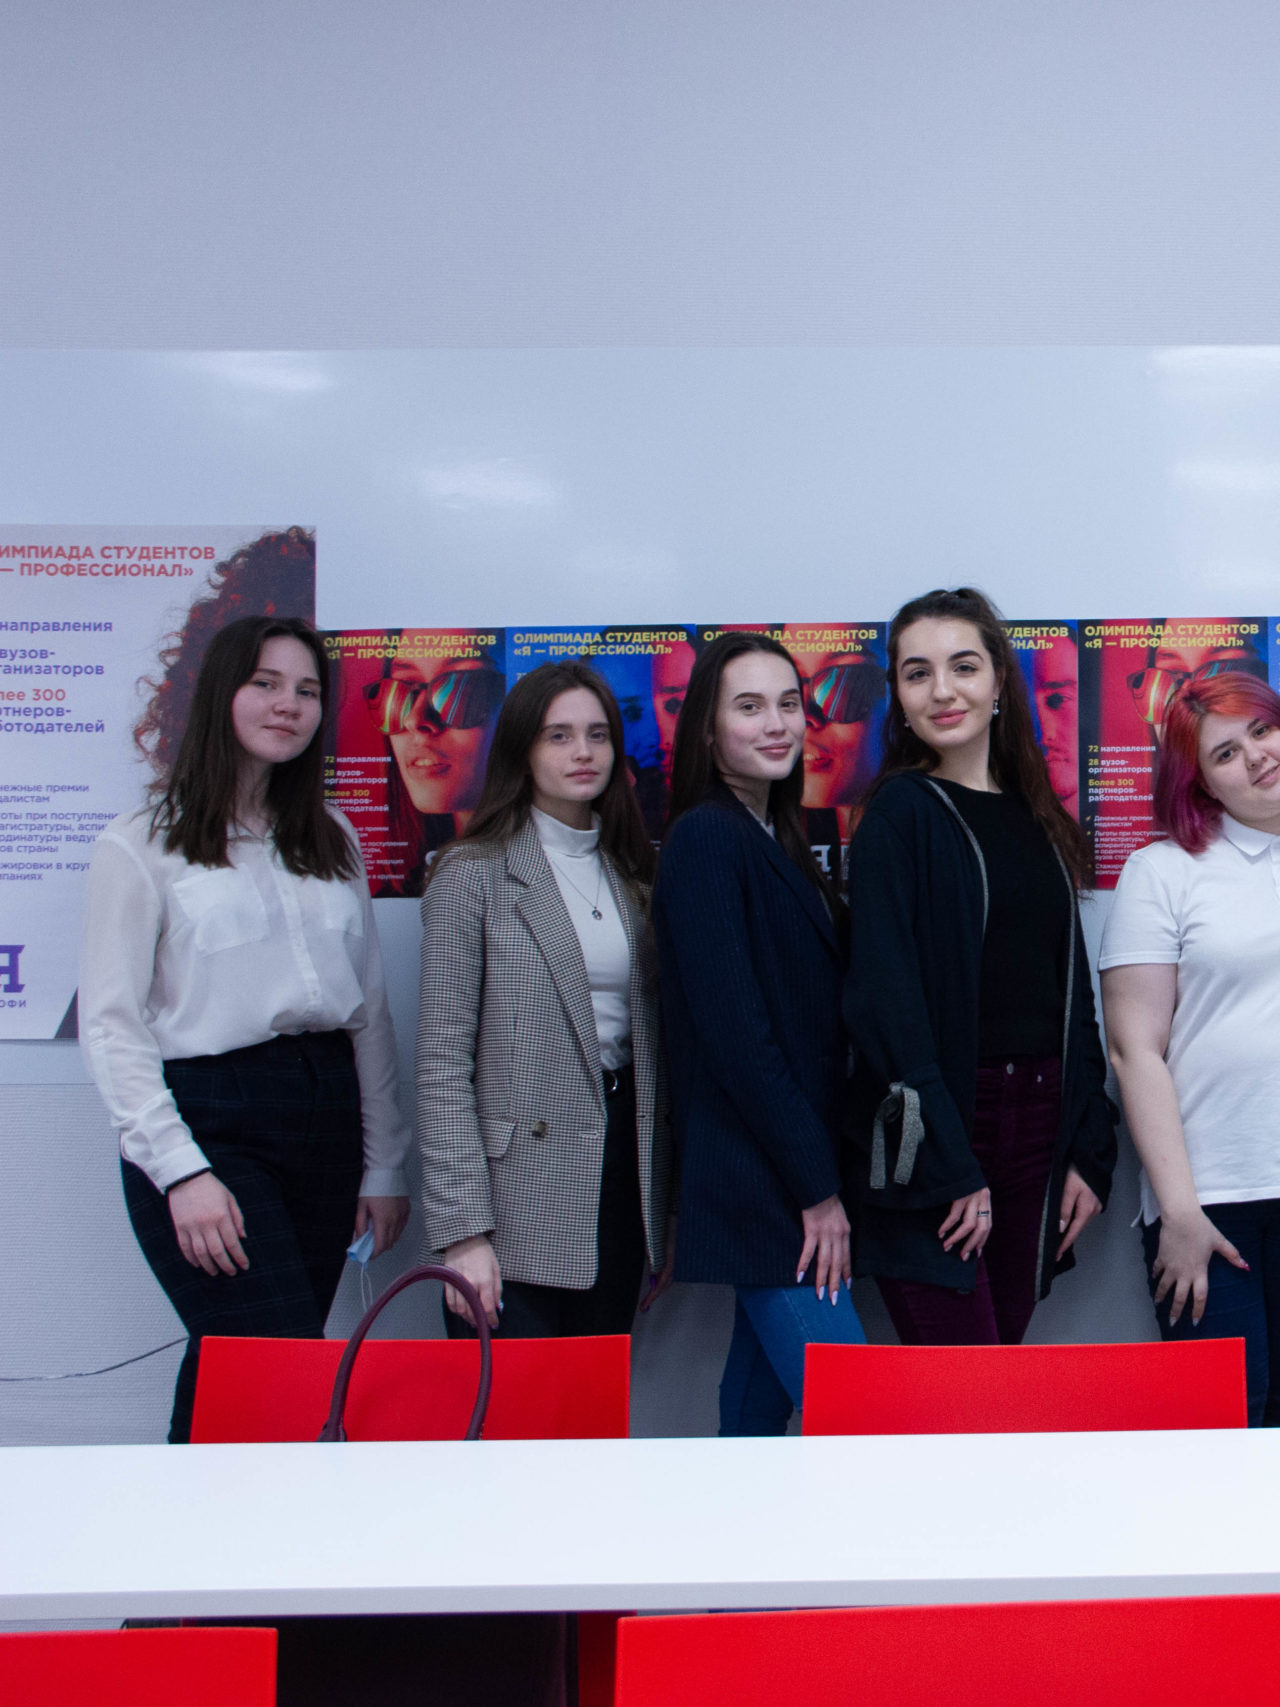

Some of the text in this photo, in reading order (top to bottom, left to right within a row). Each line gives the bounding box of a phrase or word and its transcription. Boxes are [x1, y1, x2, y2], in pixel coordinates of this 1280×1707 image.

[100, 546, 215, 560] СТУДЕНТОВ
[20, 563, 194, 577] ПРОФЕССИОНАЛ»
[0, 621, 113, 633] направления
[1085, 624, 1259, 636] ОЛИМПИАДА СТУДЕНТОВ
[324, 634, 496, 647] ОЛИМПИАДА СТУДЕНТОВ
[513, 631, 687, 644] ОЛИМПИАДА СТУДЕНТОВ
[796, 629, 877, 641] СТУДЕНТОВ
[1085, 637, 1244, 648] «Я ПРОФЕССИОНАЛ»
[0, 649, 56, 661] вузов-
[357, 648, 481, 659] ПРОФЕССИОНАЛ»
[514, 644, 673, 656] «Я ПРОФЕССИОНАЛ»
[32, 688, 66, 701] 300
[0, 707, 71, 718] тнеров-
[0, 719, 105, 734] отодателей
[46, 784, 90, 793] премии
[353, 789, 370, 797] 300
[1088, 794, 1154, 802] работодателей
[26, 813, 47, 821] при
[16, 845, 59, 854] страны
